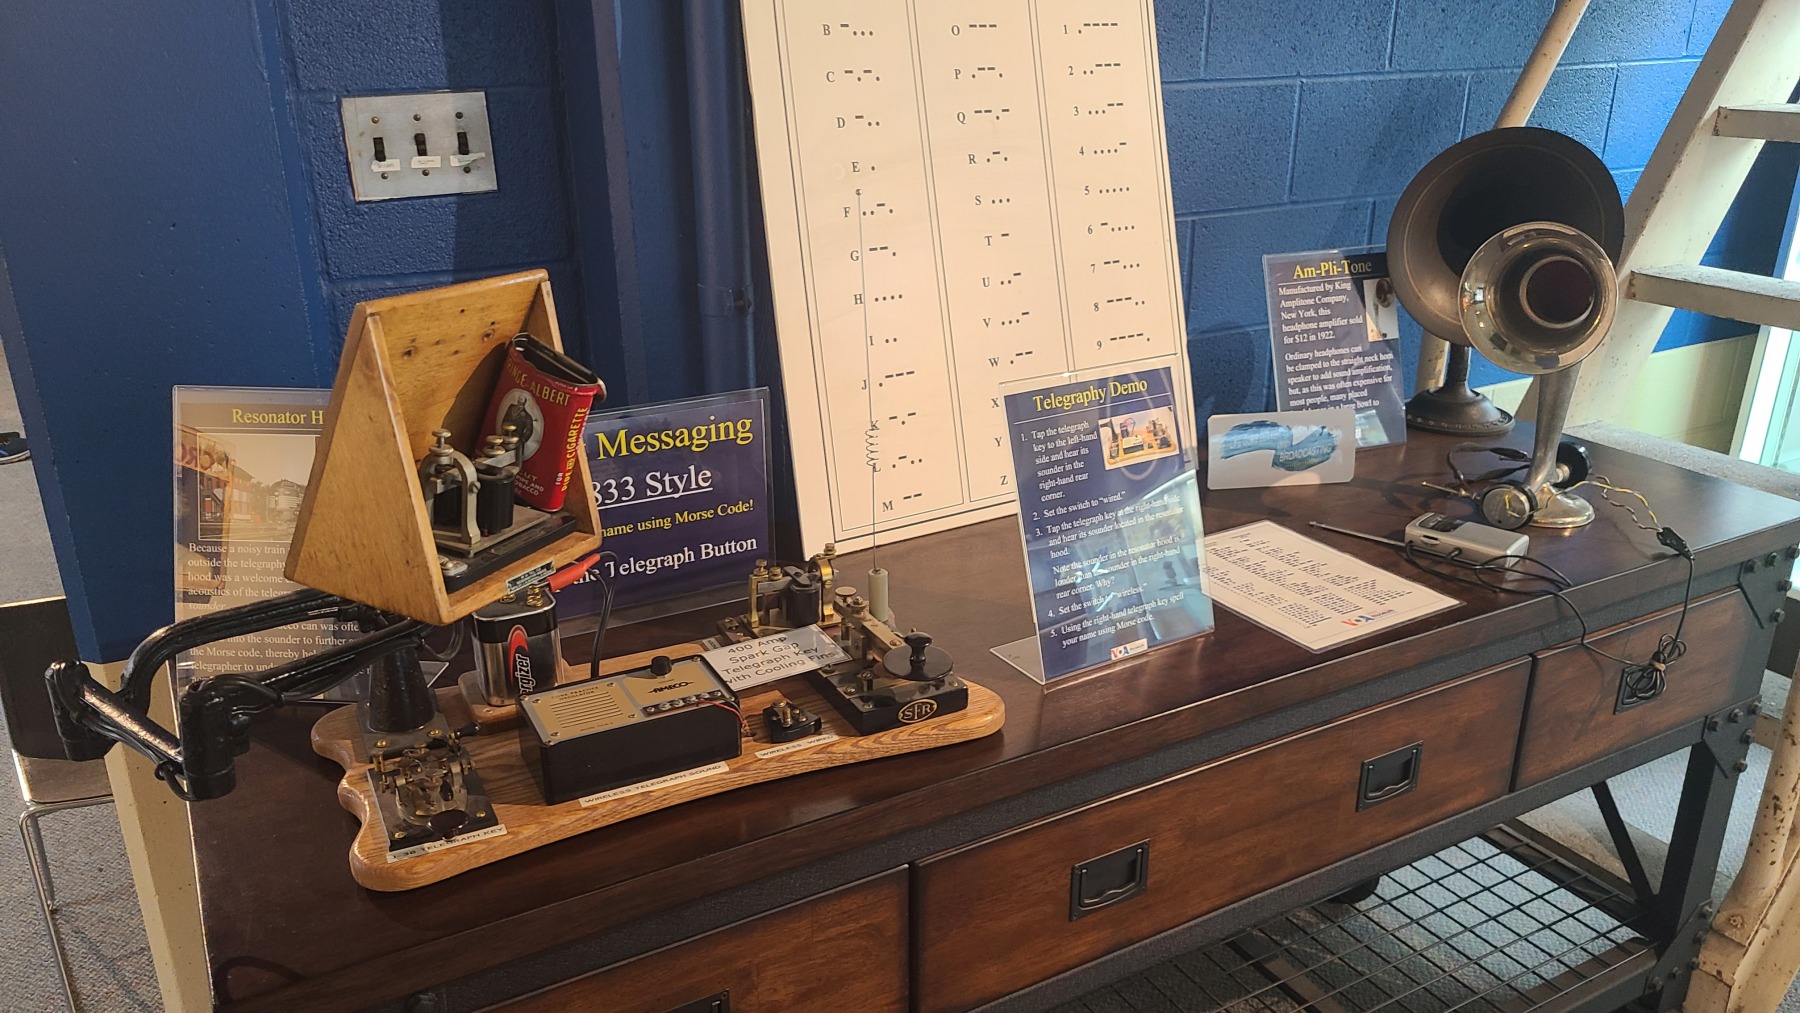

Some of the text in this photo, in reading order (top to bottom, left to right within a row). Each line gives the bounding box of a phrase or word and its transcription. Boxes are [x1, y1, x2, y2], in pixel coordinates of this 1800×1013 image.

[1293, 260, 1371, 279] Am-Pli-Tone
[1279, 281, 1352, 295] Manufactured by King
[1280, 298, 1315, 308] Amplitone
[1281, 312, 1297, 320] New
[1318, 308, 1331, 316] this
[1282, 316, 1363, 332] headphone amplifier sold
[1284, 335, 1294, 344] for
[1309, 333, 1316, 341] in
[1285, 352, 1314, 361] Ordinary
[1314, 346, 1350, 357] headphones
[530, 381, 571, 406] ALBERT
[1032, 378, 1149, 411] Telegraphy Demo
[232, 408, 324, 424] Resonator H
[566, 407, 588, 459] CIGARETTE
[594, 415, 754, 460] Messaging
[1032, 430, 1046, 440] Tap
[1046, 428, 1057, 437] the
[1058, 420, 1090, 434] telegraph
[1033, 431, 1098, 453] key to the left-hand
[1035, 446, 1090, 465] side and hear its
[1280, 442, 1333, 462] BROADCASTING
[514, 480, 539, 496] OBACCO
[530, 482, 544, 492] AND
[645, 464, 712, 498] Style
[637, 516, 672, 532] using
[675, 505, 715, 525] Morse
[717, 498, 754, 517] Code!
[1043, 509, 1056, 518] Set
[1056, 506, 1067, 515] the
[1068, 500, 1090, 512] switch
[1091, 498, 1099, 507] to
[188, 542, 228, 552] Because
[237, 545, 262, 556] noisy
[264, 544, 286, 554] train
[604, 546, 696, 578] Telegraph
[700, 538, 758, 560] Button
[188, 558, 222, 568] outside
[223, 558, 238, 568] the
[188, 572, 212, 581] hood
[214, 574, 232, 582] was
[242, 573, 283, 583] welcome
[188, 587, 230, 596] acoustics
[232, 588, 243, 597] of
[245, 588, 259, 597] the
[1060, 622, 1082, 634] Using
[1082, 618, 1093, 627] the
[1093, 608, 1127, 626] right-hand
[1127, 600, 1157, 616] telegraph
[1157, 597, 1169, 606] key
[247, 635, 262, 644] the
[264, 635, 300, 644] sounder
[303, 636, 314, 645] to
[315, 636, 346, 646] further
[728, 636, 787, 654] 400 Amp
[190, 648, 204, 656] the
[206, 648, 236, 657] Morse
[238, 649, 263, 659] code,
[265, 649, 300, 660] thereby
[722, 646, 818, 675] Telegraph Key
[729, 642, 800, 664] Spark Gap
[244, 663, 254, 672] to
[754, 660, 806, 676] Cooling
[808, 652, 836, 662] Fins
[902, 702, 932, 721] SFR
[760, 743, 802, 758] WIRELESS
[584, 764, 722, 804] WIRELESS TELEGRAPH SOUND
[483, 826, 504, 836] KEY
